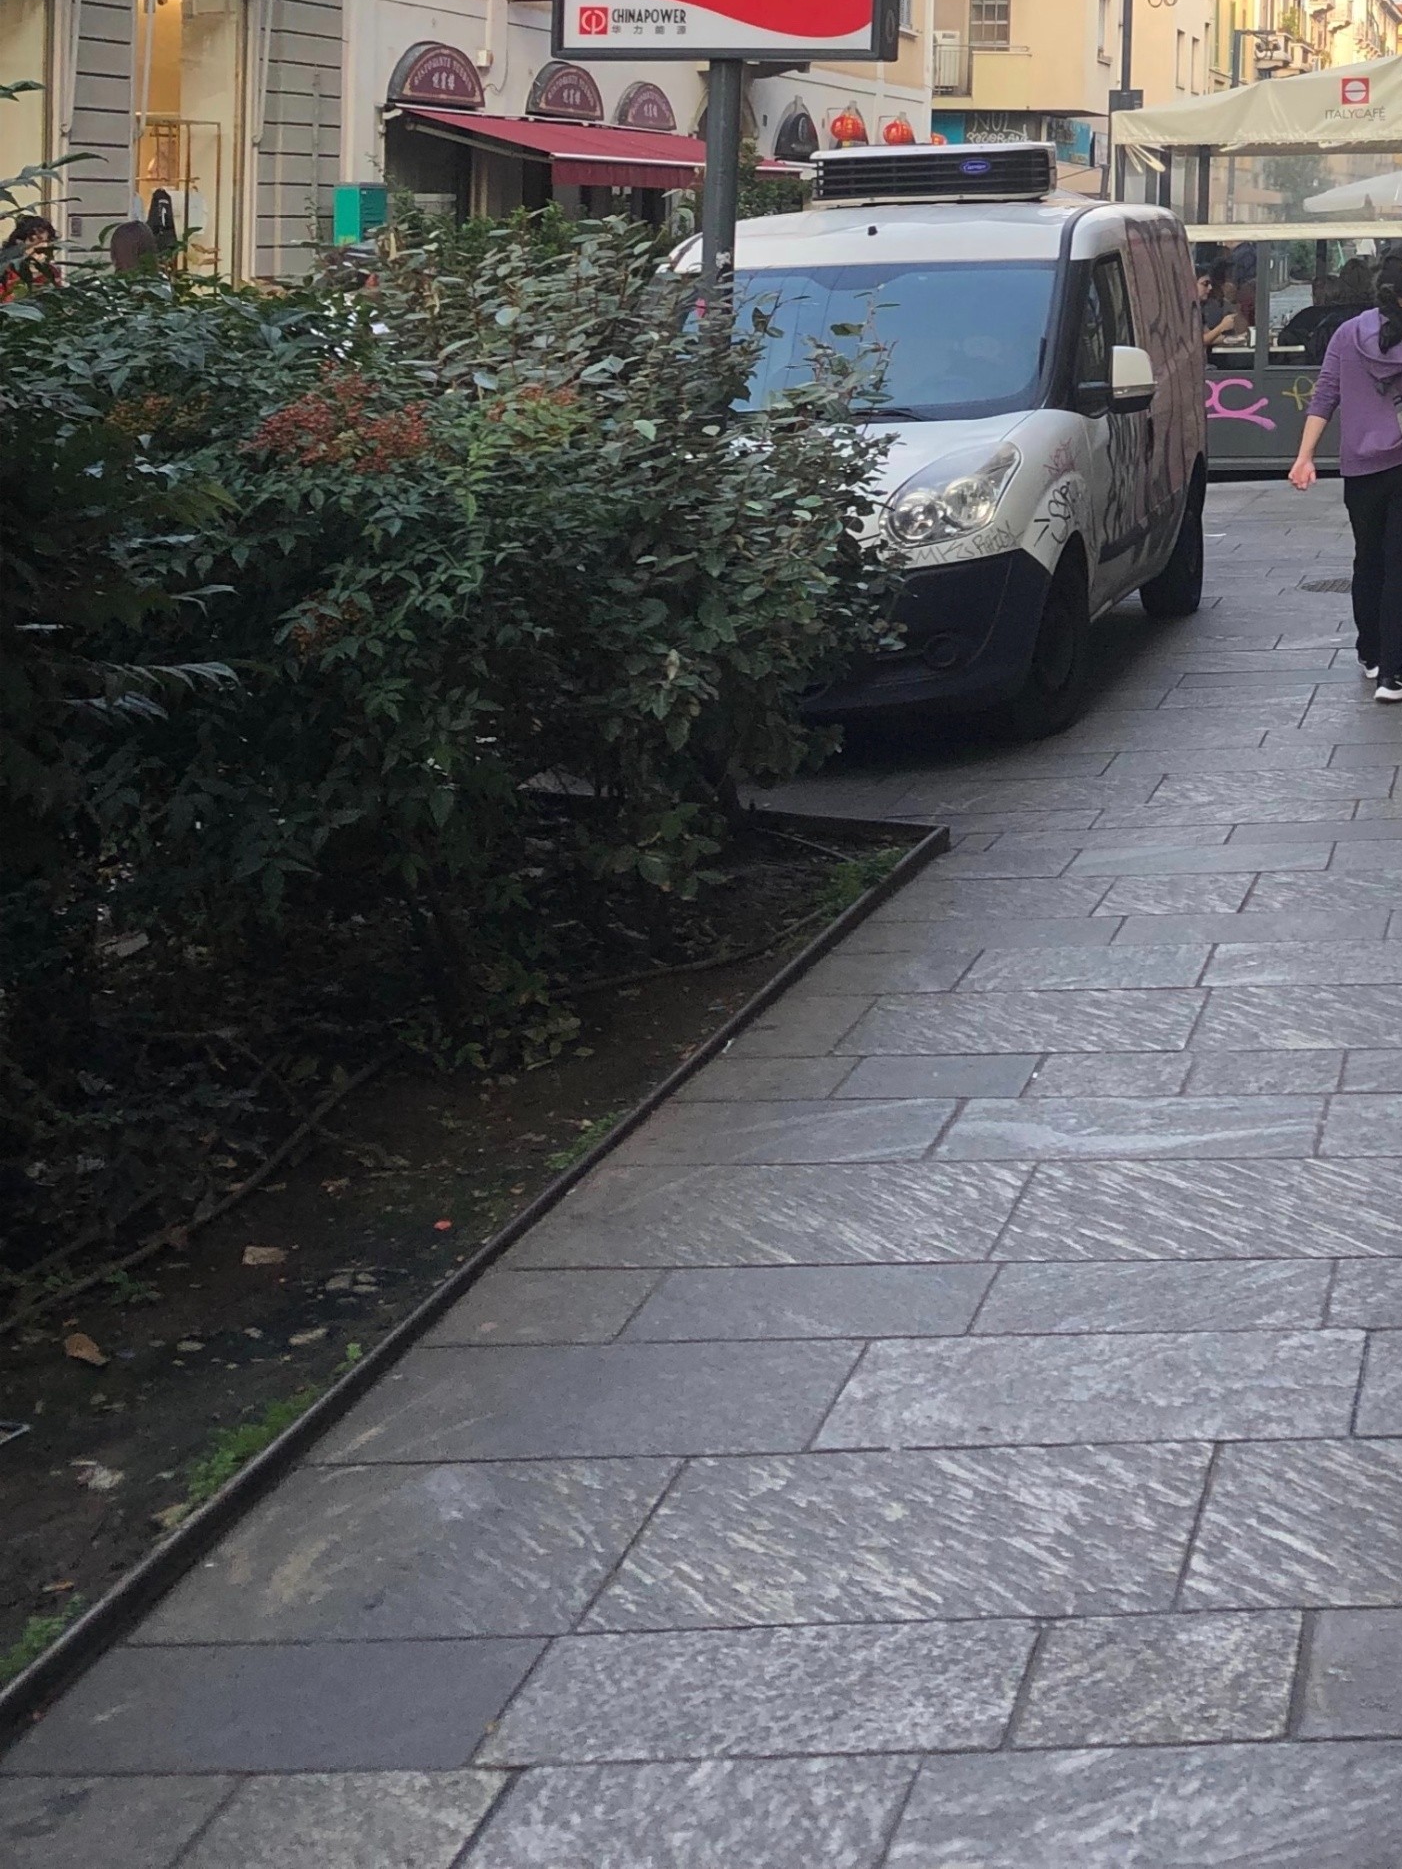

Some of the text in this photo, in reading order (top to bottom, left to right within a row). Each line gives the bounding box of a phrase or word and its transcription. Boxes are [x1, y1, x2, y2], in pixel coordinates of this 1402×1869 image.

[611, 8, 687, 24] CHINAPOWER
[611, 25, 687, 35] 华力能源
[1325, 105, 1386, 120] ITALYCAFÉ
